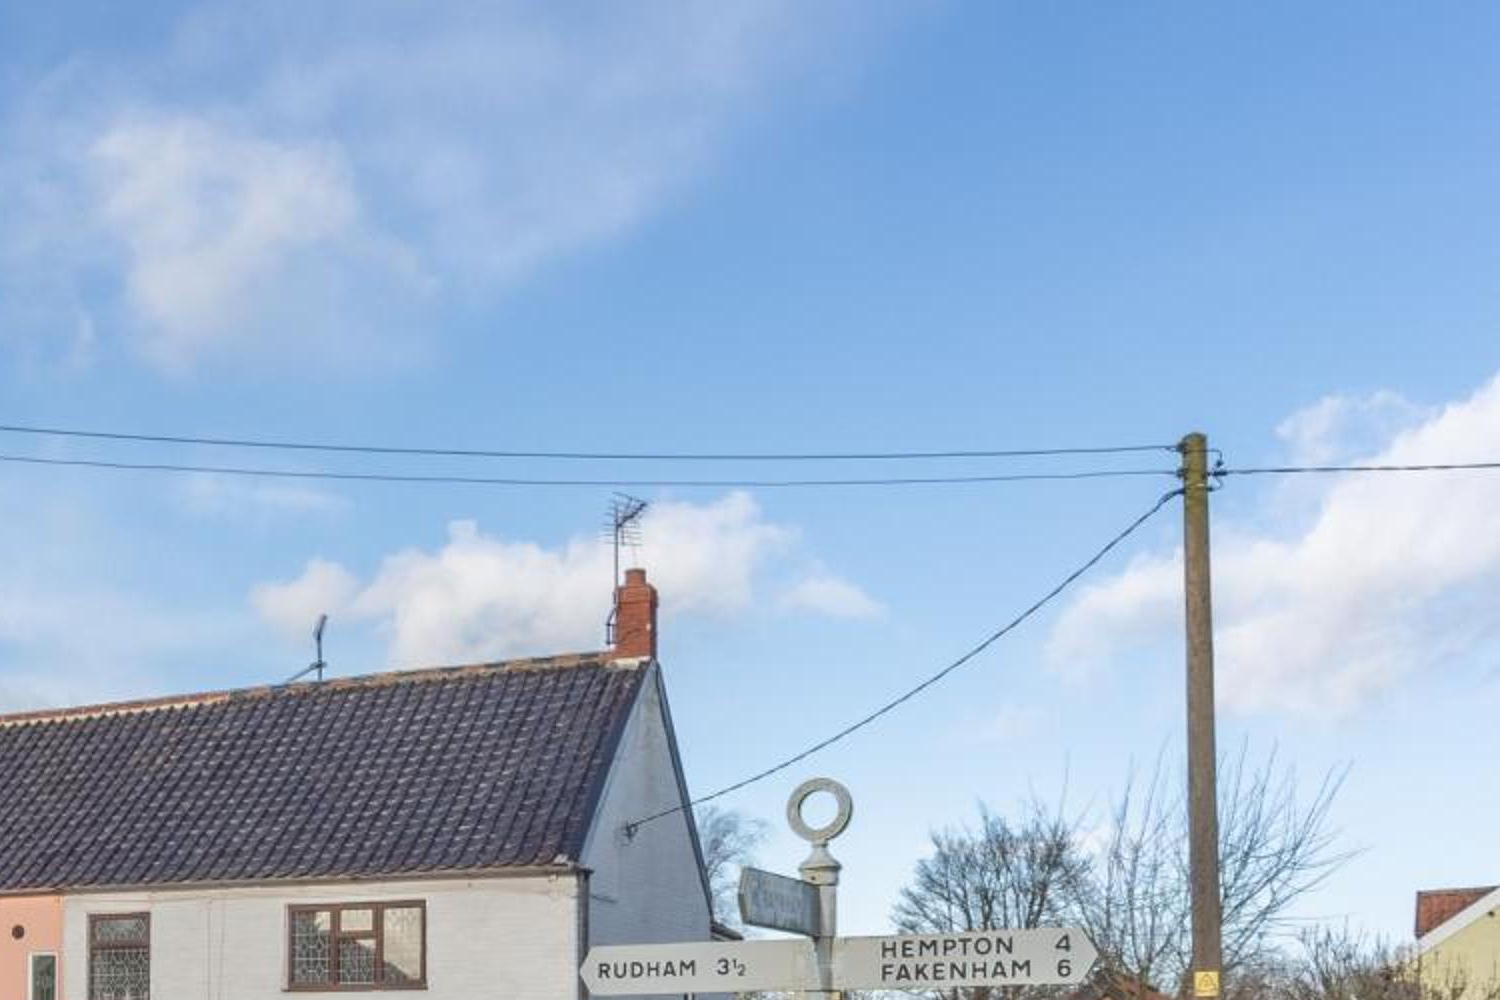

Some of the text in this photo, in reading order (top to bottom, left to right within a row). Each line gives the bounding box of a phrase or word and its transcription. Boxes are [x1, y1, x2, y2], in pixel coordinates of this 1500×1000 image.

[880, 933, 1072, 959] HEMPTON 4
[597, 958, 697, 980] RUDHAM
[880, 958, 1072, 982] FAKENHAM 6
